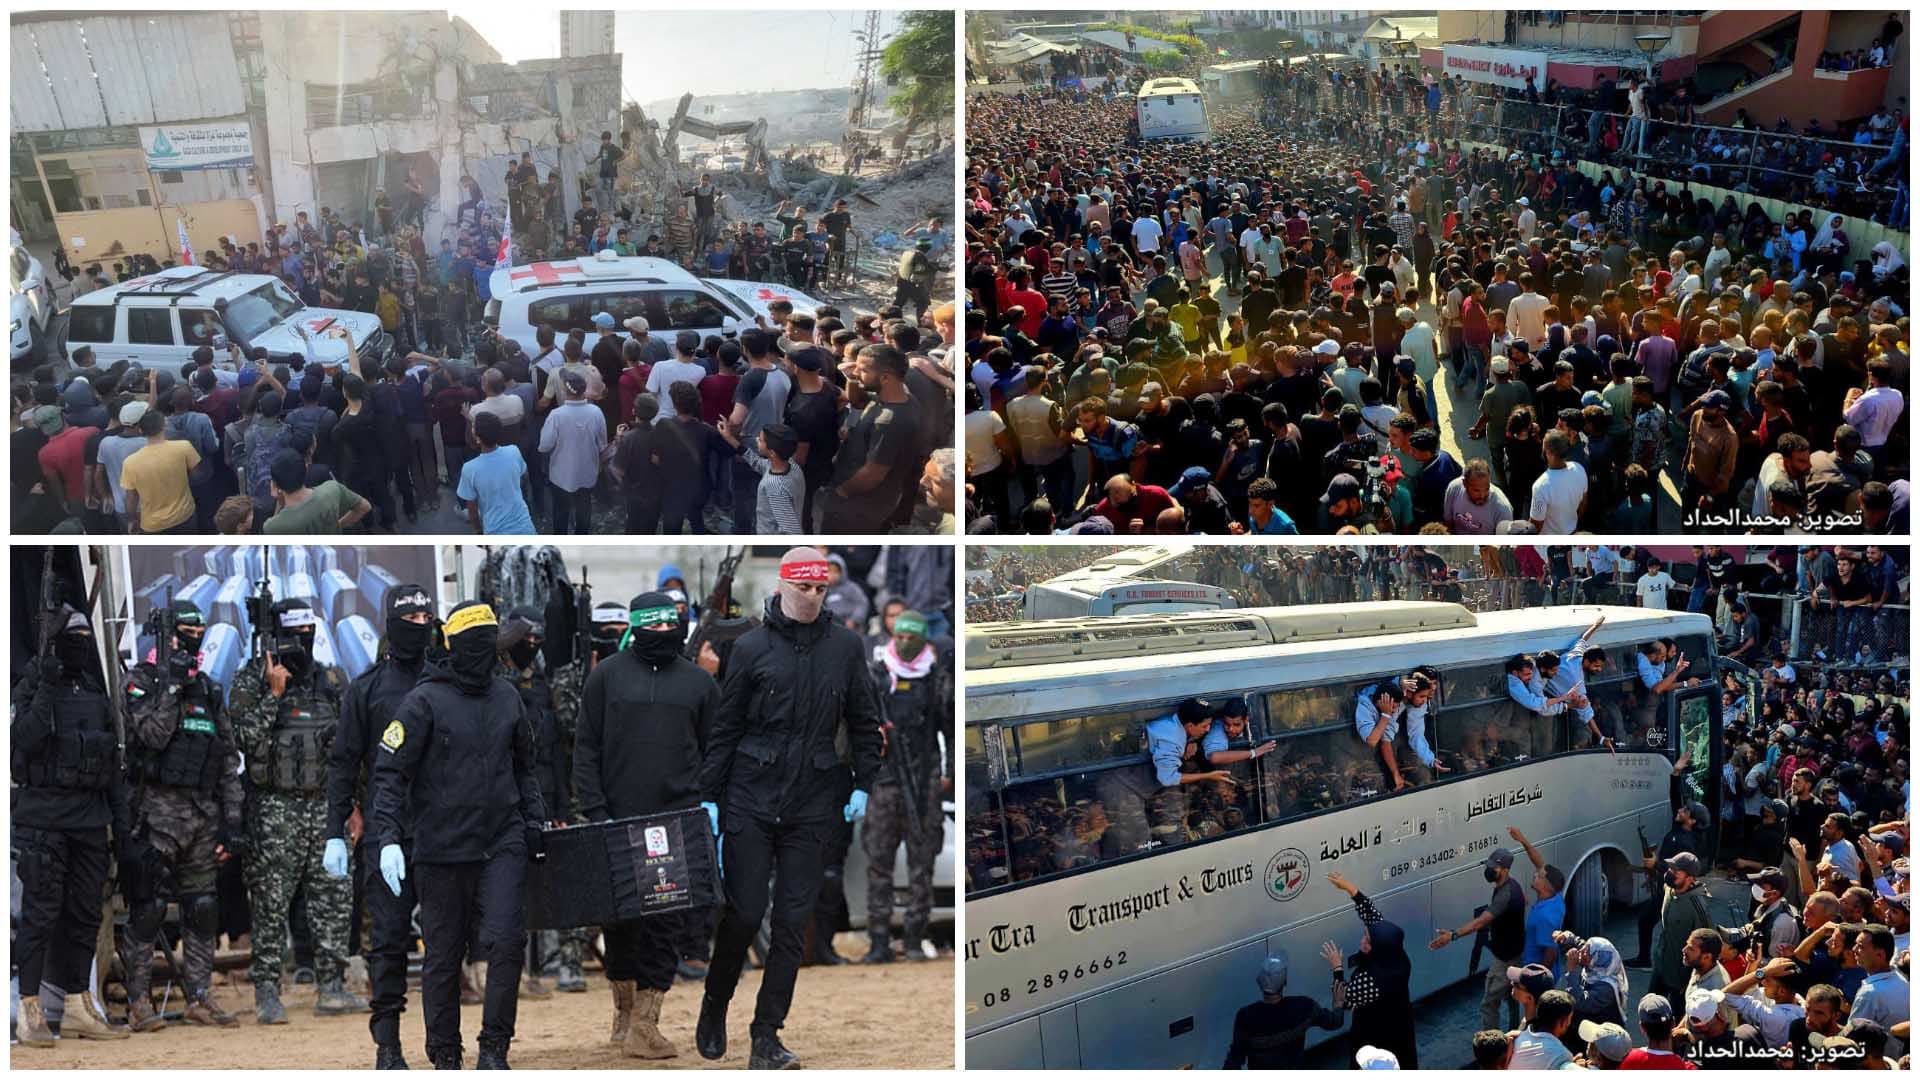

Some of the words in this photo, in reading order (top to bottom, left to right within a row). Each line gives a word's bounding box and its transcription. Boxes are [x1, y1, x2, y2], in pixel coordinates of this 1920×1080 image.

[1463, 793, 1506, 822] التفاضل
[1508, 784, 1543, 808] شركة
[1320, 830, 1368, 862] العامة
[989, 923, 1036, 953] Tra
[1068, 884, 1170, 932] Transport
[1177, 876, 1194, 901] &
[1200, 863, 1253, 893] Tours
[984, 988, 1011, 1007] 08
[1027, 951, 1128, 994] 2896662
